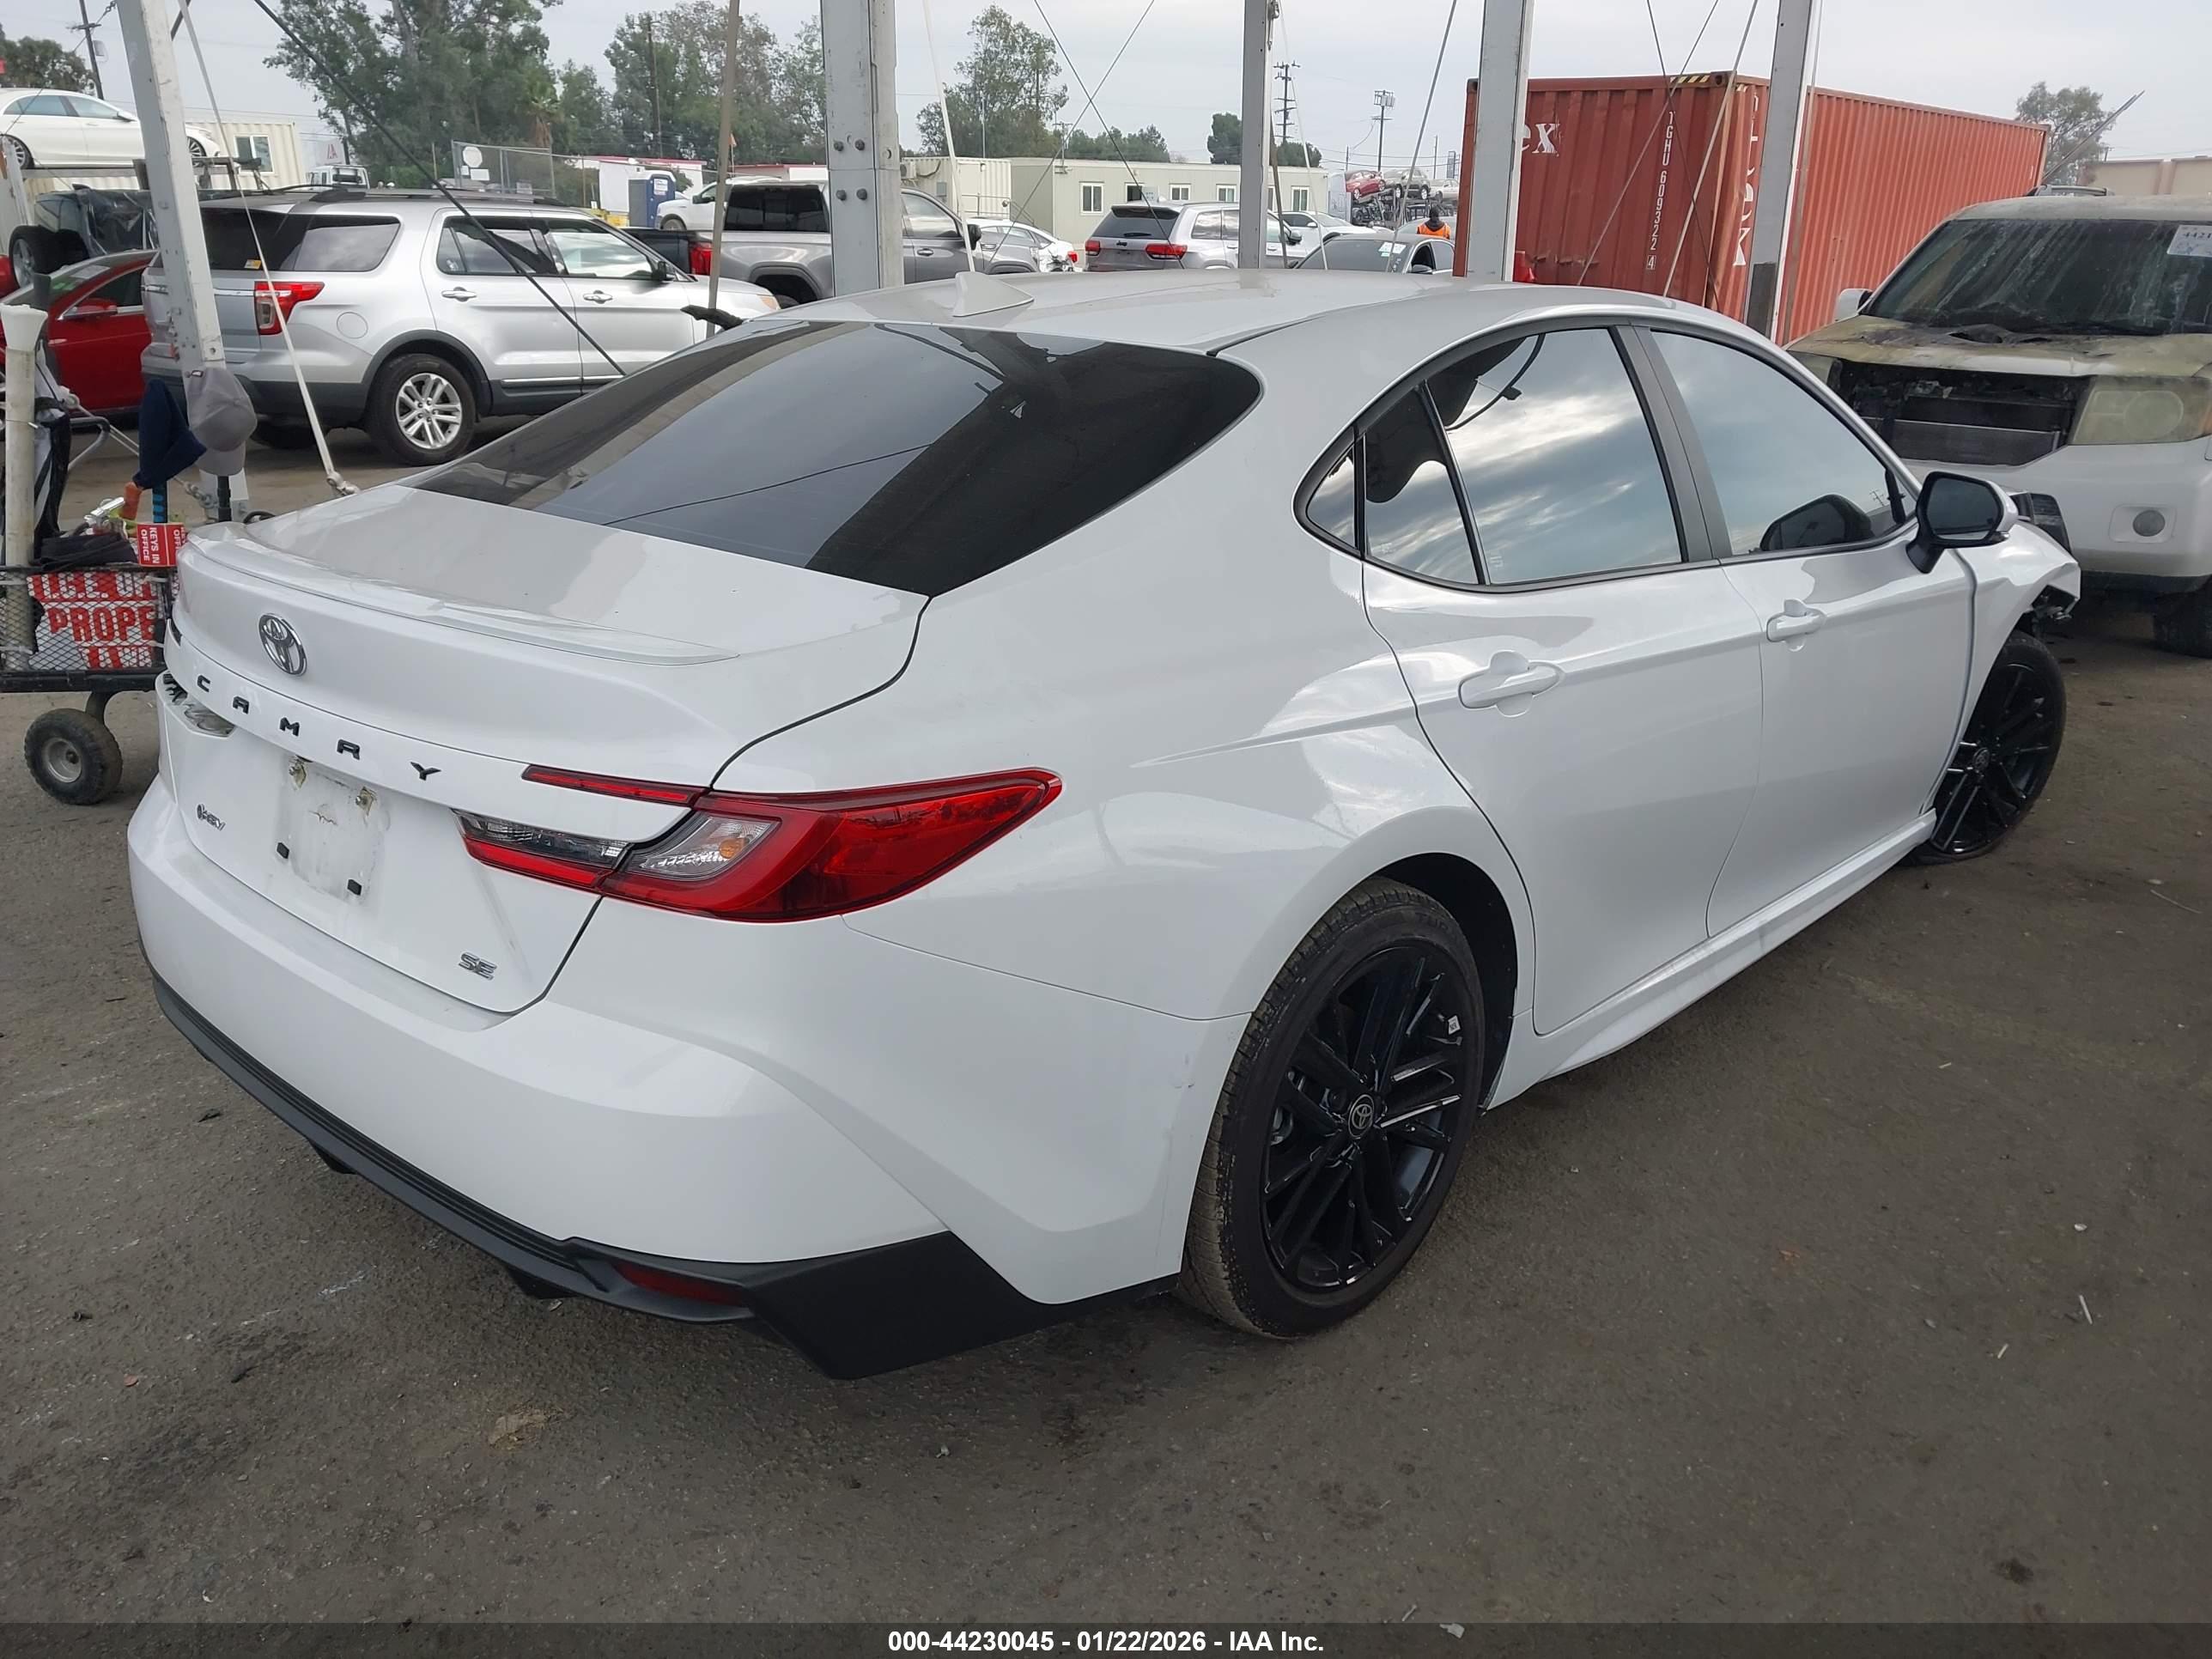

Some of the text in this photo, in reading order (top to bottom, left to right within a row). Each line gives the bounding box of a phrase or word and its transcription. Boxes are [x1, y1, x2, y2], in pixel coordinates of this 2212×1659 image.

[1650, 170, 1668, 251] 609322
[141, 529, 150, 562] OFFICE
[149, 527, 161, 564] KEYS IN
[197, 674, 441, 781] CAMRY
[458, 951, 498, 981] SE
